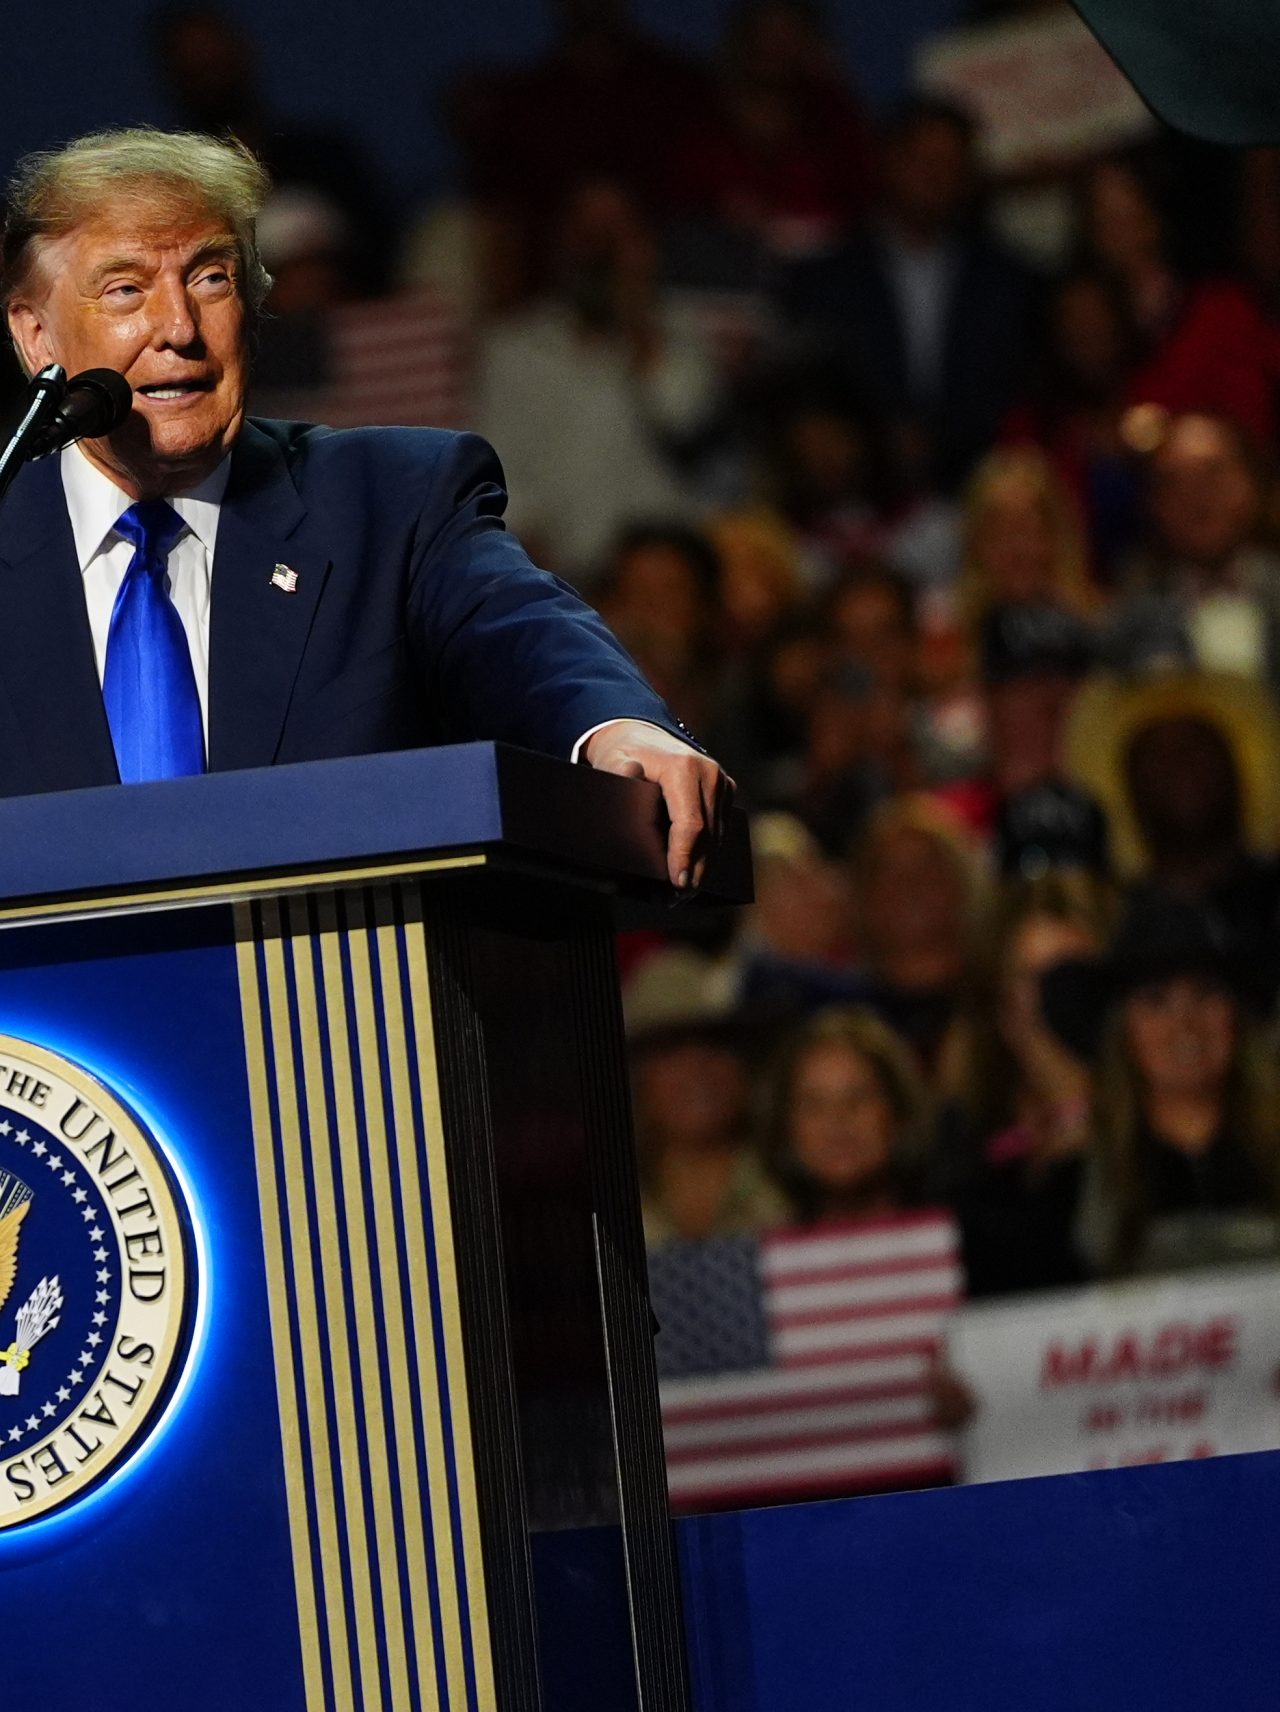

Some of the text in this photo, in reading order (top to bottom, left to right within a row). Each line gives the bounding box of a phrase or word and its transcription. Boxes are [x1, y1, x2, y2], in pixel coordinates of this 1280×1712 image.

[59, 1096, 166, 1302] UNITED
[6, 1335, 156, 1502] STATES
[1042, 1315, 1236, 1387] MADE
